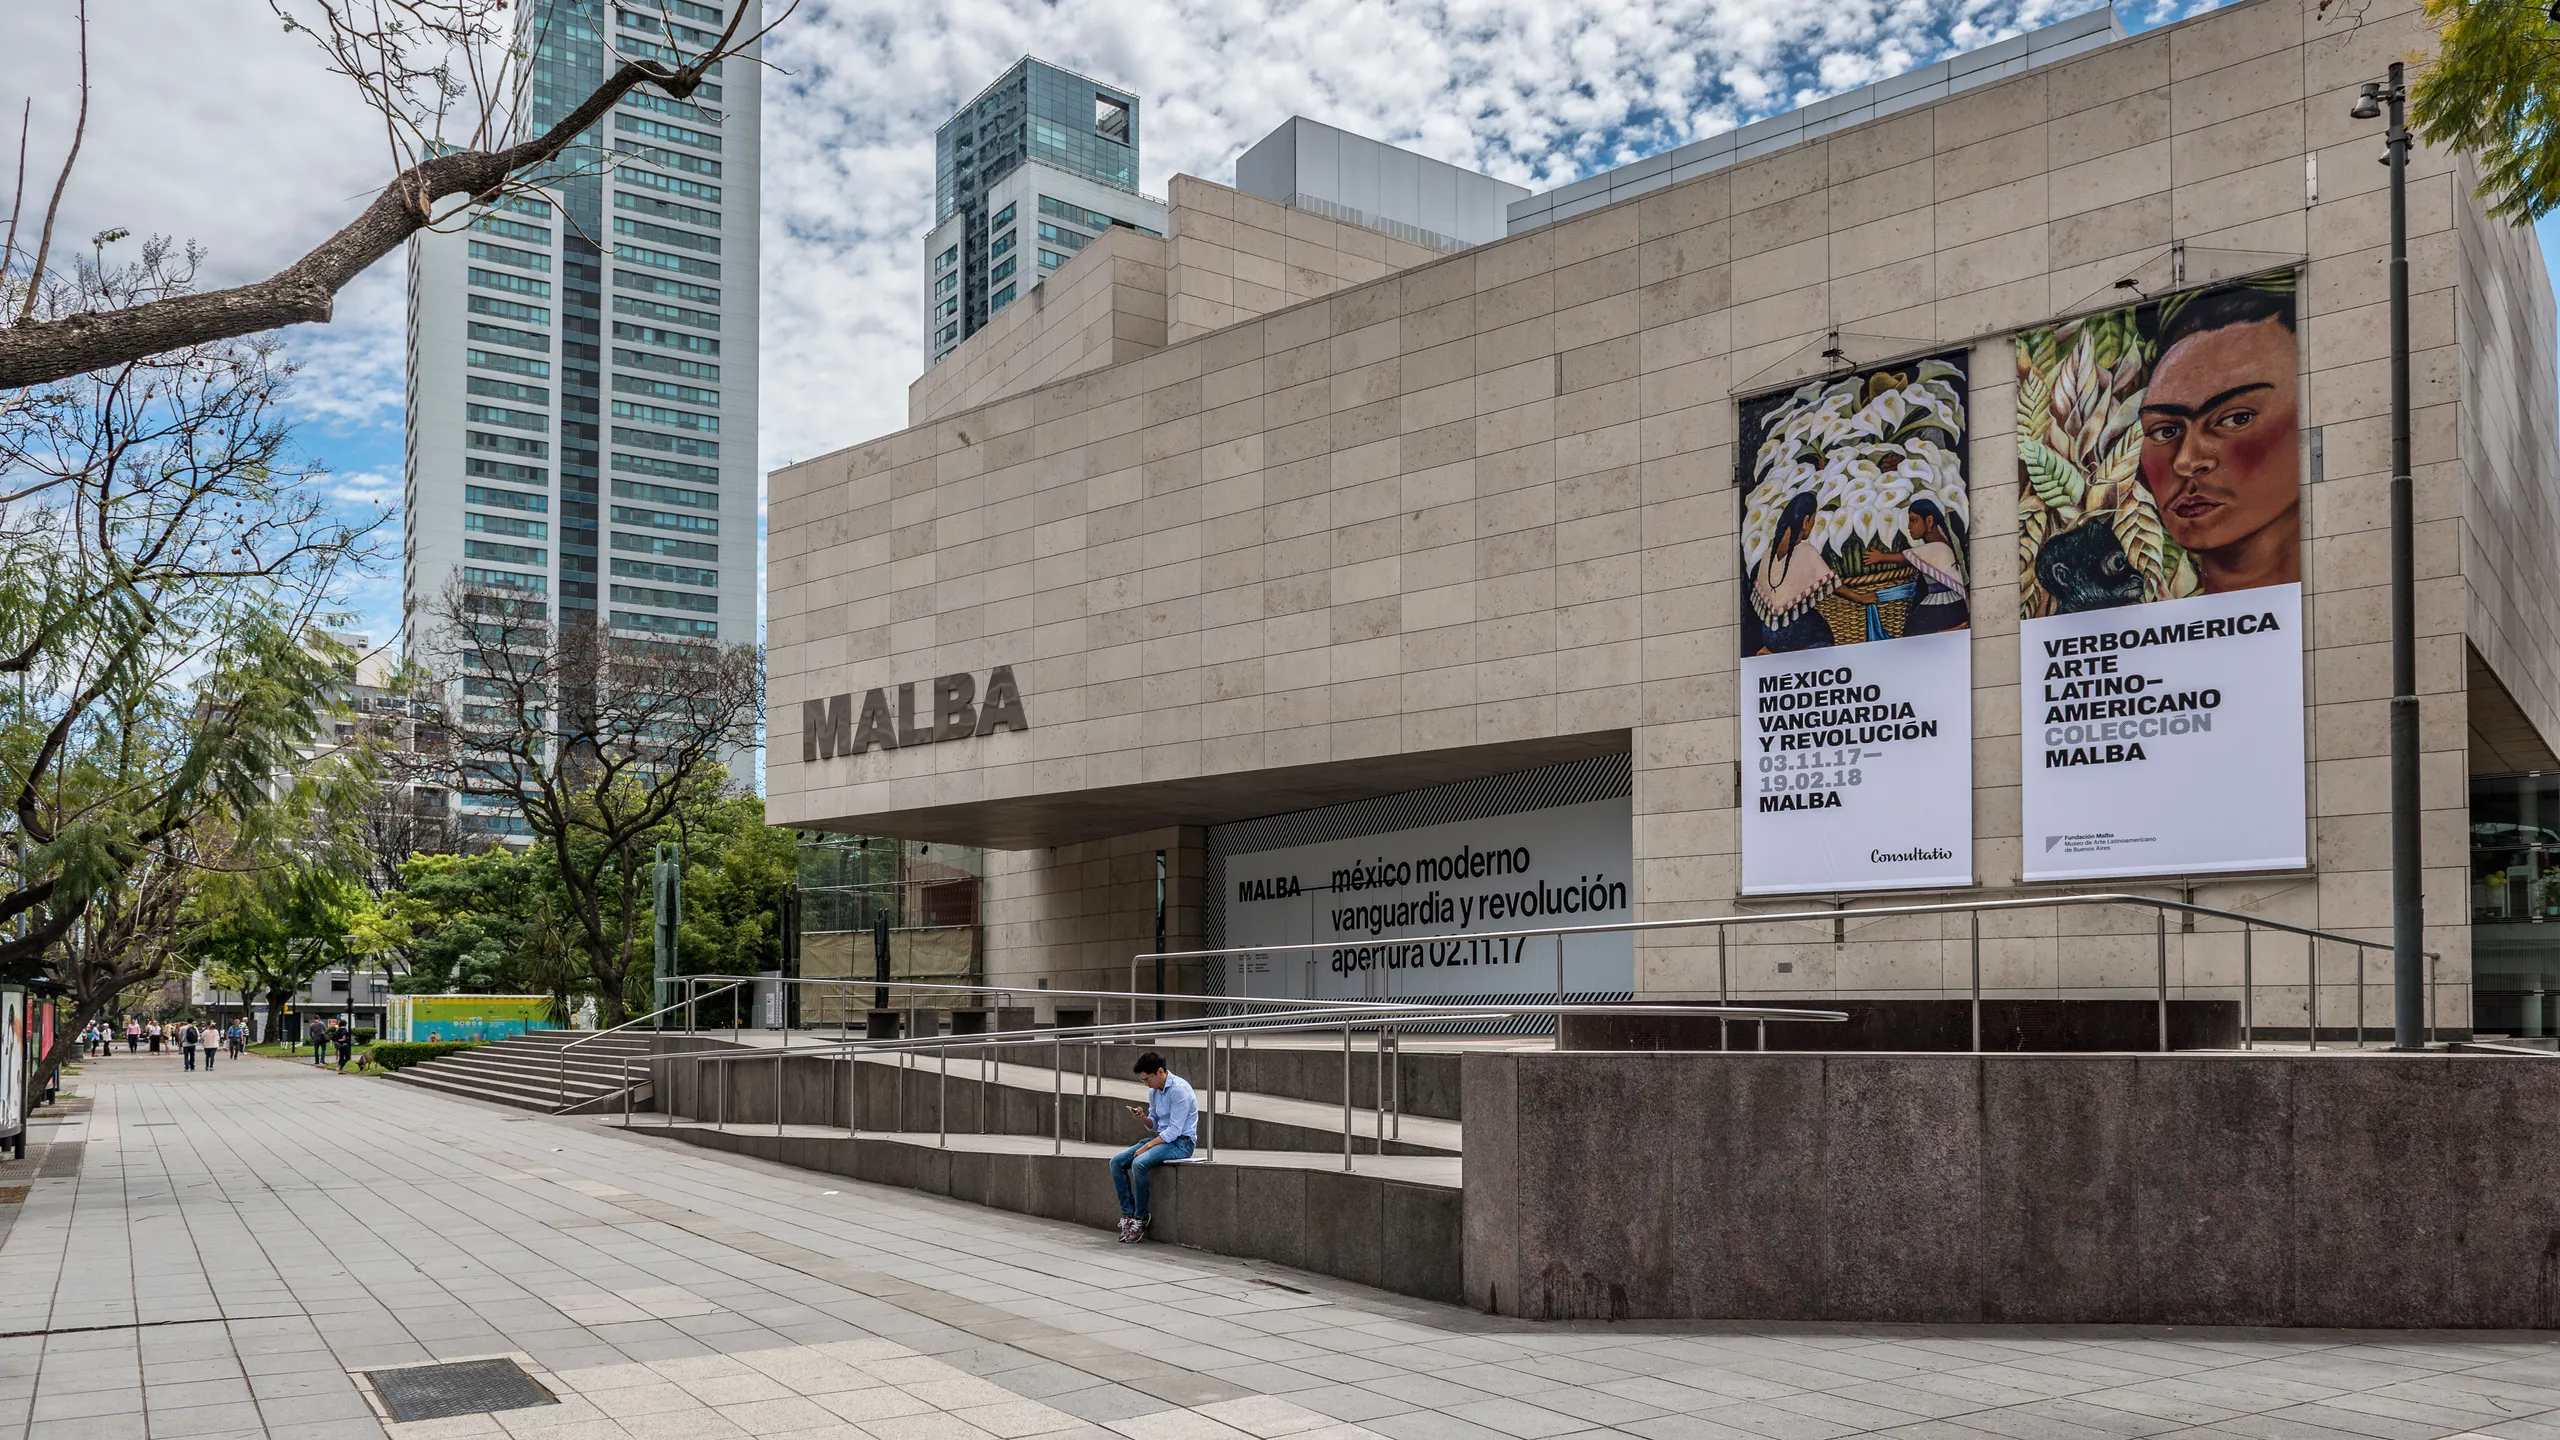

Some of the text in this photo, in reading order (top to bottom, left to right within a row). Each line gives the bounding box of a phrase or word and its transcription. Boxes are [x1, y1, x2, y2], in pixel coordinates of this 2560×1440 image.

[2044, 612, 2280, 658] VERBOAMÉRICA
[1759, 667, 1852, 693] MÉXICO
[2044, 655, 2118, 681] ARTE
[803, 664, 1028, 762] MALBA
[1759, 684, 1881, 713] MODERNO
[2044, 689, 2221, 724] AMERICANO
[1759, 702, 1916, 732] VANGUARDIA
[2045, 713, 2212, 747] COLECCIÓN
[1759, 720, 1938, 752] Y REVOLUCIÓN
[2045, 742, 2147, 769] MALBA
[1760, 768, 1862, 793] 19.02.18
[1759, 791, 1842, 813] MALBA
[1331, 845, 1530, 893] méxico moderno
[1871, 847, 1953, 863] Consultatio
[1239, 875, 1301, 903] MALBA
[1331, 874, 1626, 935] vanguardia y revolución
[1429, 934, 1526, 967] 02.11.17
